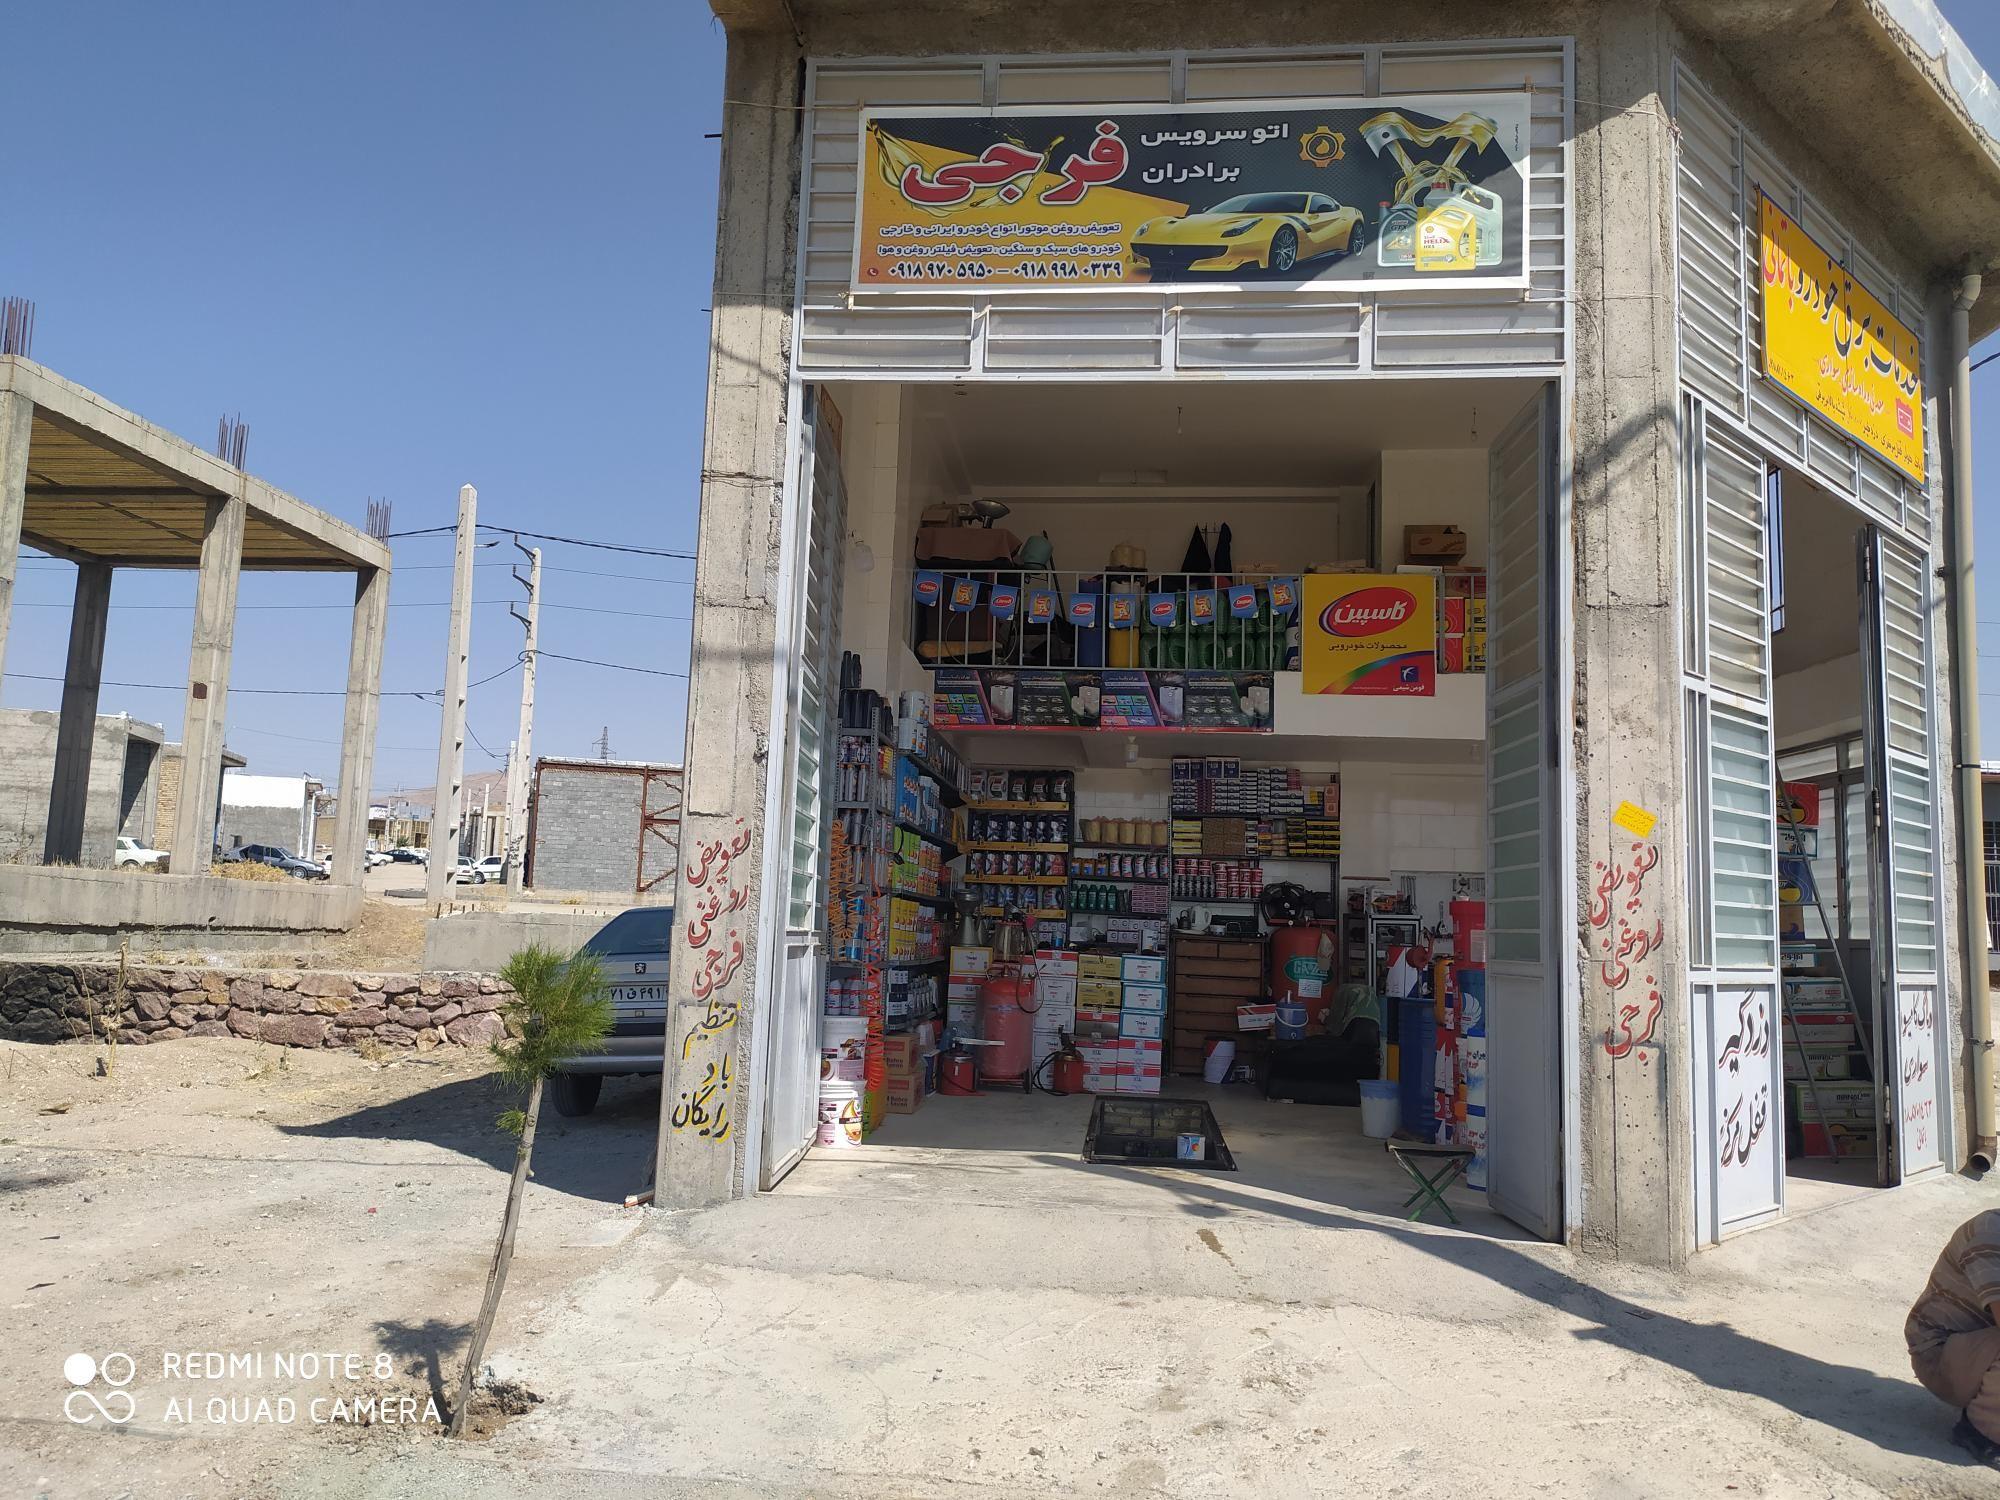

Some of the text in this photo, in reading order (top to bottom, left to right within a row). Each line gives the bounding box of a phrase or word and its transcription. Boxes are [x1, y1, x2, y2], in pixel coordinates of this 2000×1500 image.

[1139, 122, 1290, 147] اتو سرویس
[903, 119, 1130, 206] فرجی
[1142, 161, 1241, 184] برادران
[880, 225, 914, 238] خارجی
[923, 225, 956, 237] ایرانی
[957, 224, 990, 236] خودرو
[991, 223, 1017, 237] انواع
[1018, 225, 1049, 237] موتور
[1051, 224, 1080, 236] روغن
[1081, 223, 1120, 235] تعویض
[877, 245, 896, 255] هوا
[903, 244, 929, 256] روغن
[930, 244, 956, 256] فیلتر
[957, 244, 993, 256] تعویض
[1000, 245, 1033, 257] سنگین
[1042, 244, 1068, 255] سبک
[1068, 244, 1088, 254] های
[1091, 244, 1122, 256] خودرو
[889, 261, 923, 279] ۰۹۱۸
[926, 261, 953, 279] ۹۷۰
[956, 261, 993, 279] ۵۹۵۰
[1012, 261, 1048, 279] ۰۹۱۸
[1050, 261, 1080, 279] ۹۹۸
[1082, 261, 1122, 279] ۰۳۳۹
[1794, 259, 1840, 322] خودرو
[1834, 280, 1870, 367] برق
[1869, 325, 1919, 397] خدمات
[1333, 600, 1408, 626] کاسپین
[1328, 641, 1408, 652] محصولات خودرویی
[687, 816, 752, 889] تعویض
[1588, 841, 1659, 929] تعویض
[688, 884, 750, 949] روغن
[1601, 917, 1664, 990] روغن
[691, 929, 745, 1002] فرجی
[682, 999, 741, 1061] تنظیم
[1604, 974, 1664, 1066] فرجی
[1718, 987, 1770, 1080] دزدگیر
[703, 1052, 734, 1092] باد
[1904, 1046, 1929, 1087] سواری
[671, 1085, 732, 1140] رایگان
